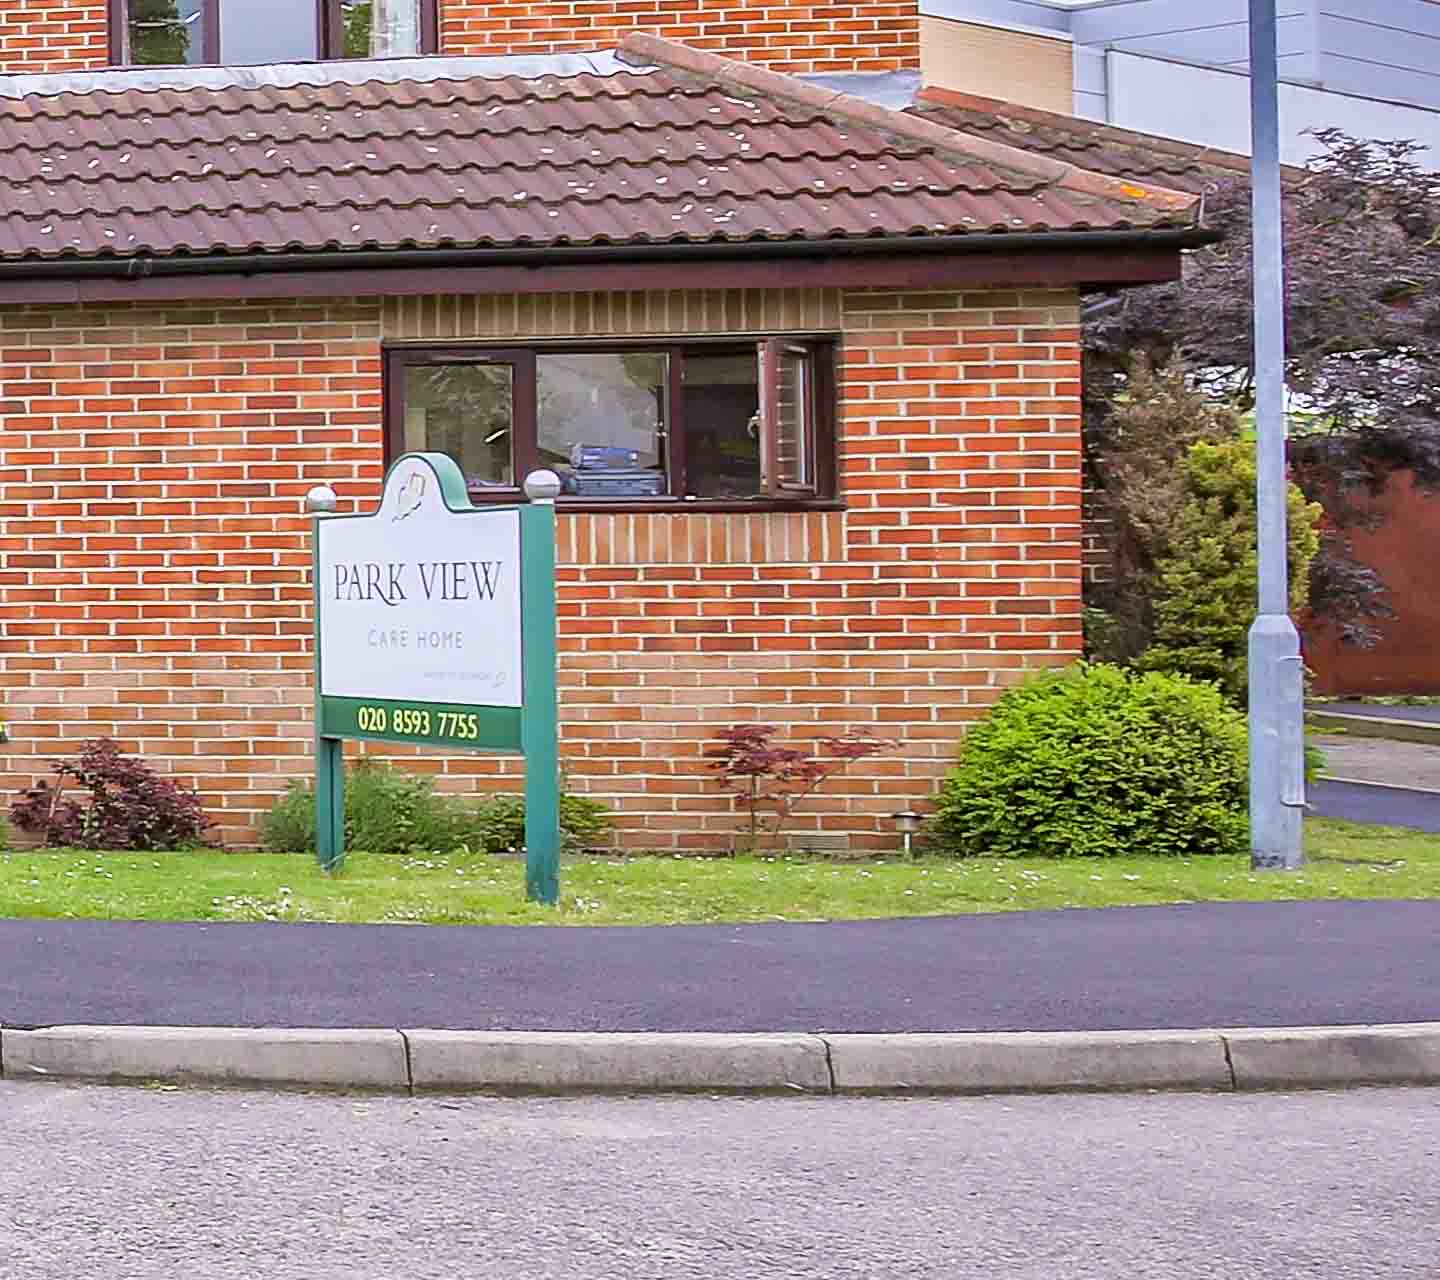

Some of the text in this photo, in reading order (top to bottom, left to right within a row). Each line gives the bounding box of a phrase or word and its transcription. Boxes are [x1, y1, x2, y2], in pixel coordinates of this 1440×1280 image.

[334, 561, 502, 606] PARK VIEW
[368, 629, 464, 648] CARE HOME
[358, 706, 478, 739] 020 8593 7755
